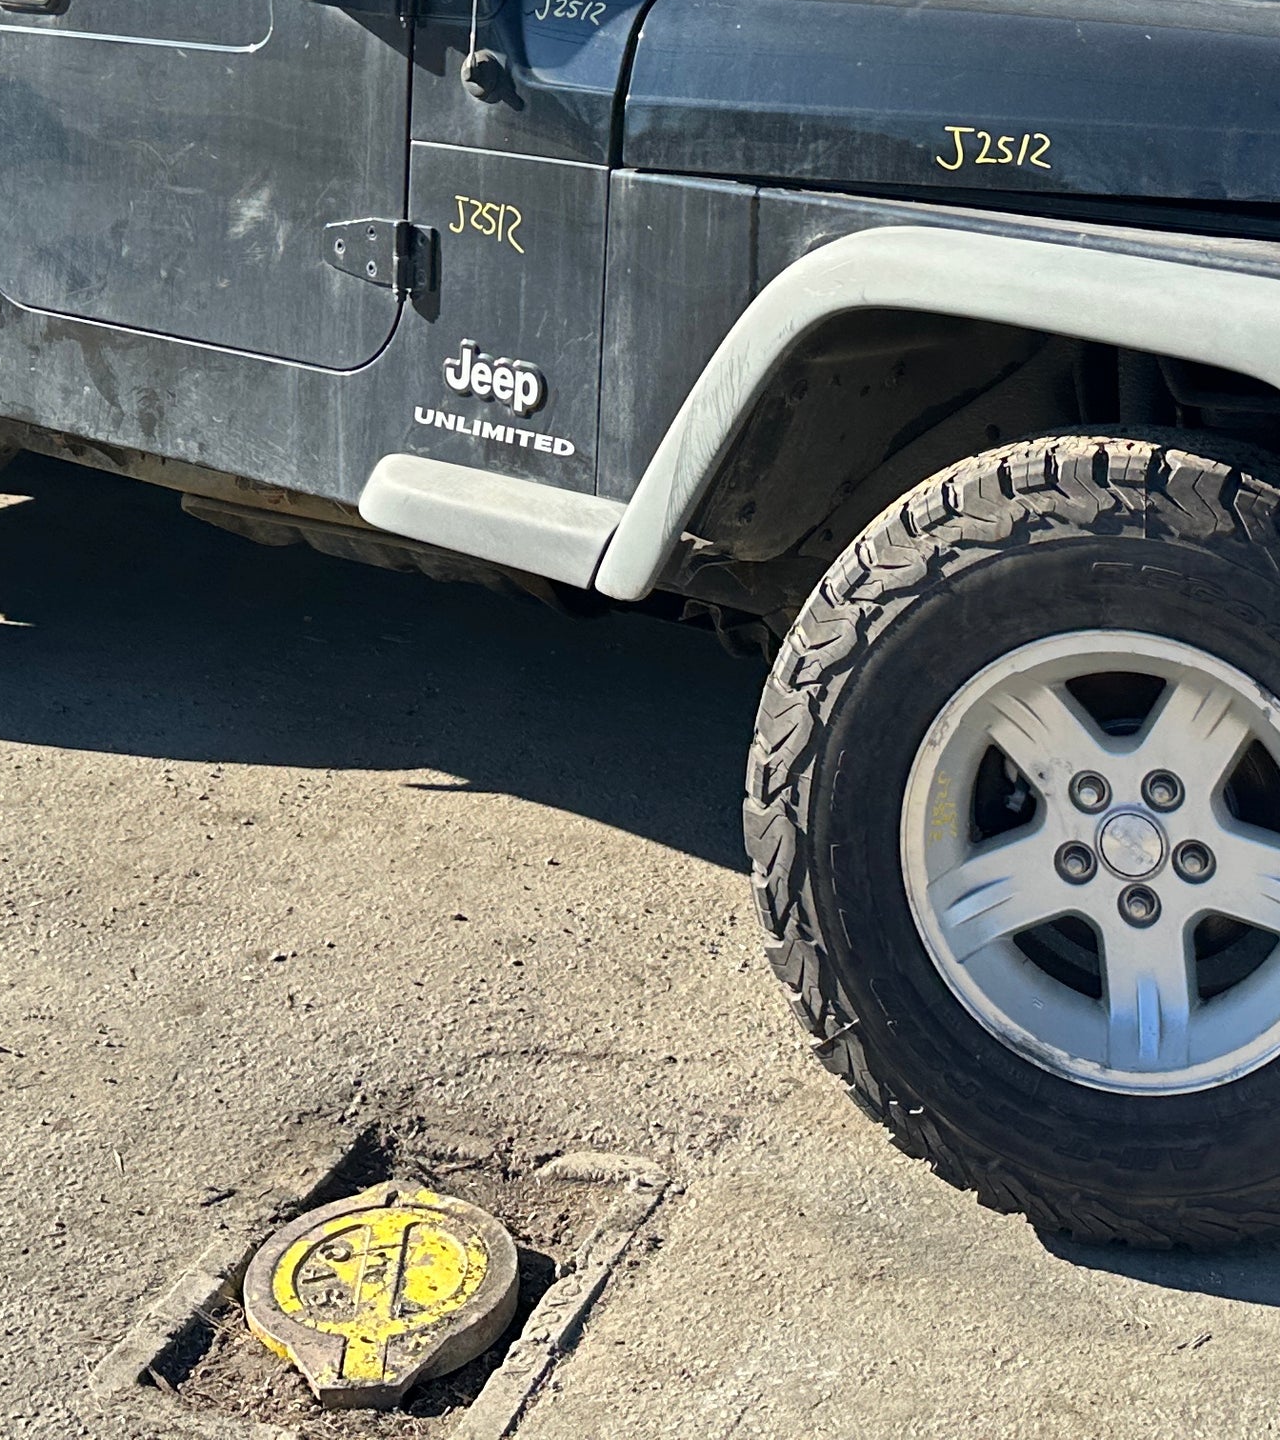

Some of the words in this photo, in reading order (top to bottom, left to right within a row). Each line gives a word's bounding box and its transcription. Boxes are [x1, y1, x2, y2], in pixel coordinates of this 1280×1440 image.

[935, 125, 1052, 171] J2512
[449, 195, 524, 254] J2512
[444, 338, 548, 418] Jeep
[414, 406, 575, 457] UNLIMITED
